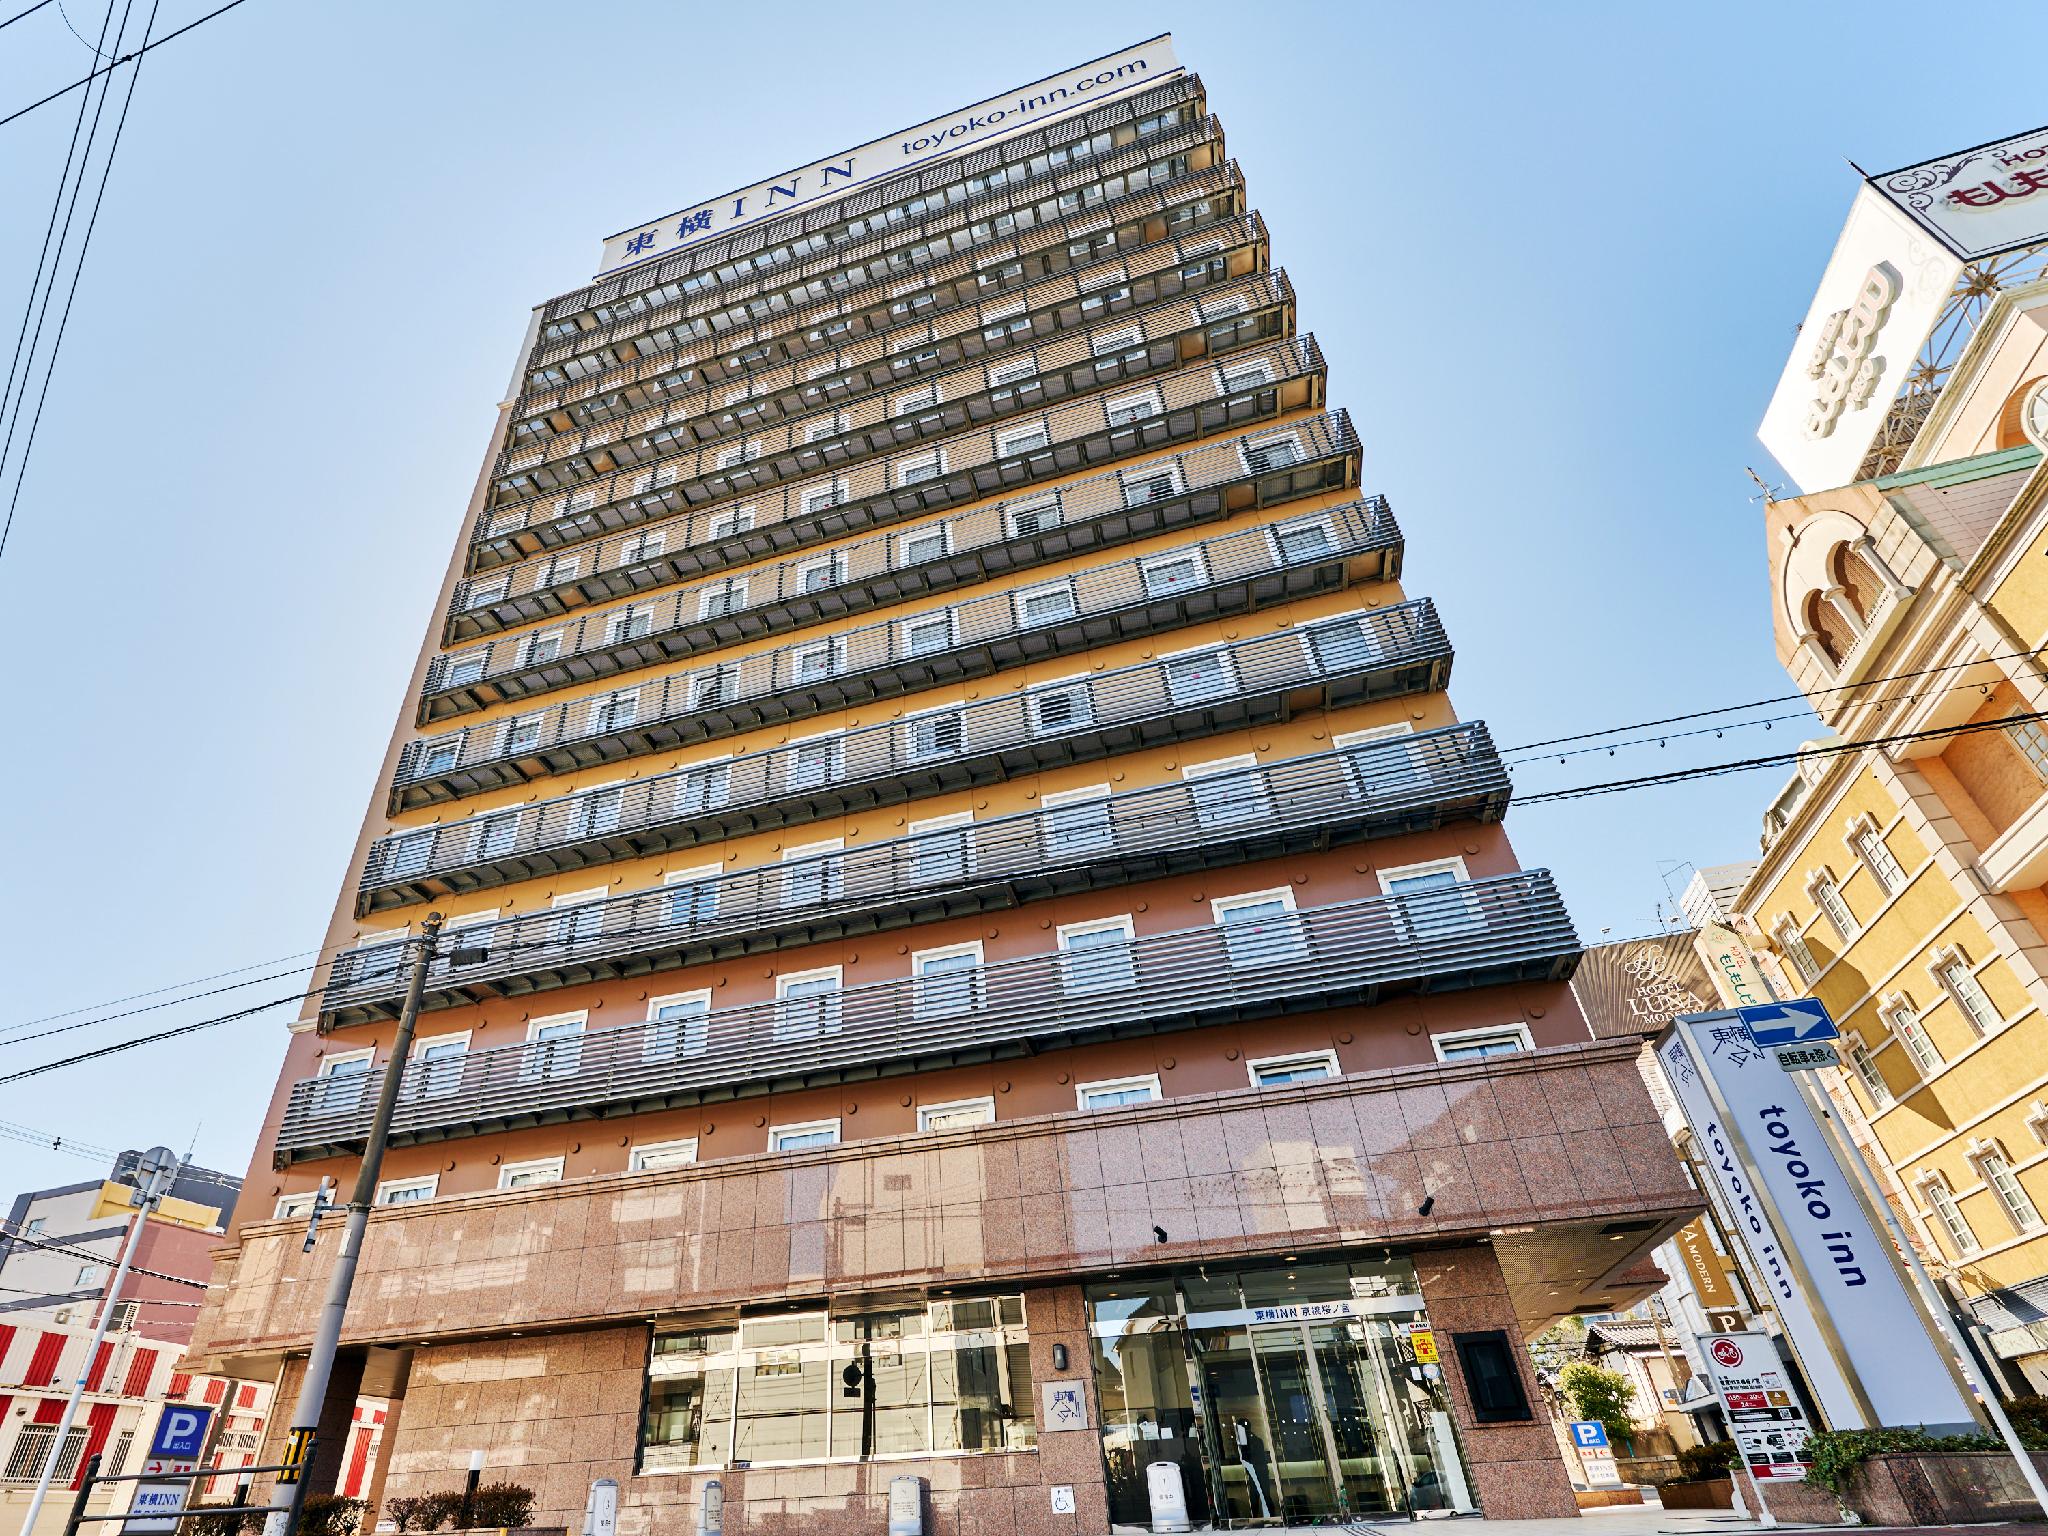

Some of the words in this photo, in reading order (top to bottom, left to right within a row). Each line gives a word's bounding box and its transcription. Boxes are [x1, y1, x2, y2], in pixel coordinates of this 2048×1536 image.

[901, 58, 1148, 155] toyoko-inn.com
[1730, 945, 1748, 969] HOTEL
[1636, 981, 1685, 997] HOTEL
[1626, 990, 1705, 1016] LUNA
[1778, 1048, 1836, 1067] 自転車を除く
[1759, 1104, 1832, 1220] toyoko
[1821, 1231, 1867, 1287] inn
[1707, 1121, 1762, 1235] toyoko
[1763, 1244, 1792, 1299] inn
[1688, 1244, 1717, 1294] MODERN
[1254, 1308, 1297, 1321] 東横INN
[1718, 1314, 1736, 1333] P
[162, 1412, 198, 1449] P
[1576, 1424, 1598, 1445] P
[172, 1441, 192, 1450] 出入口
[137, 1493, 181, 1506] 東横INN
